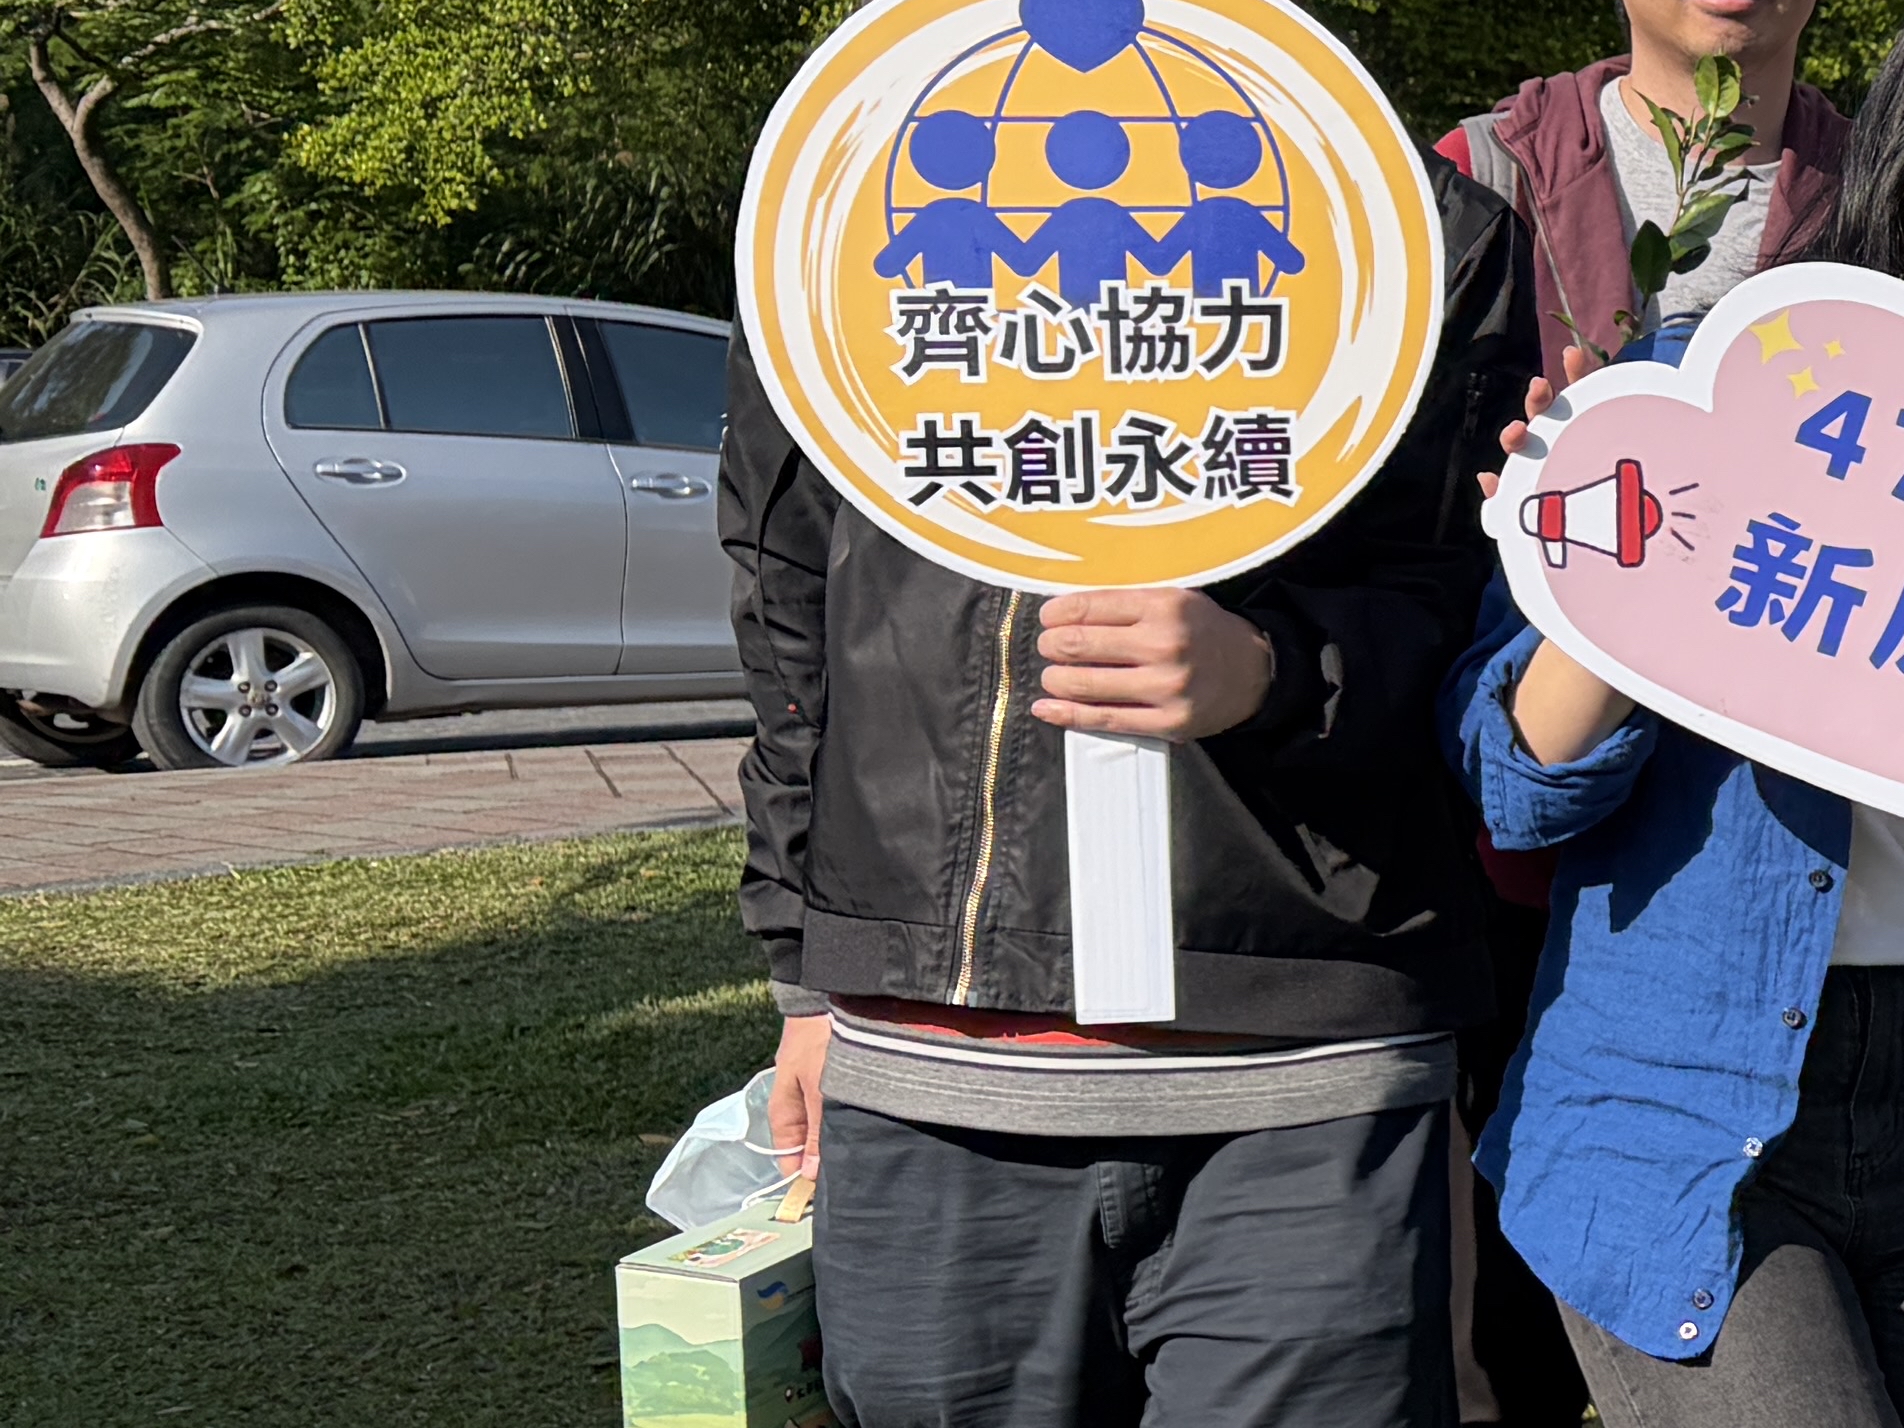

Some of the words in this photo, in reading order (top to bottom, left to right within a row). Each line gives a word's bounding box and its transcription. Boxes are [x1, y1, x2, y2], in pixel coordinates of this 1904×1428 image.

[897, 285, 1283, 377] 齊心協力
[904, 414, 1295, 505] 共創永續
